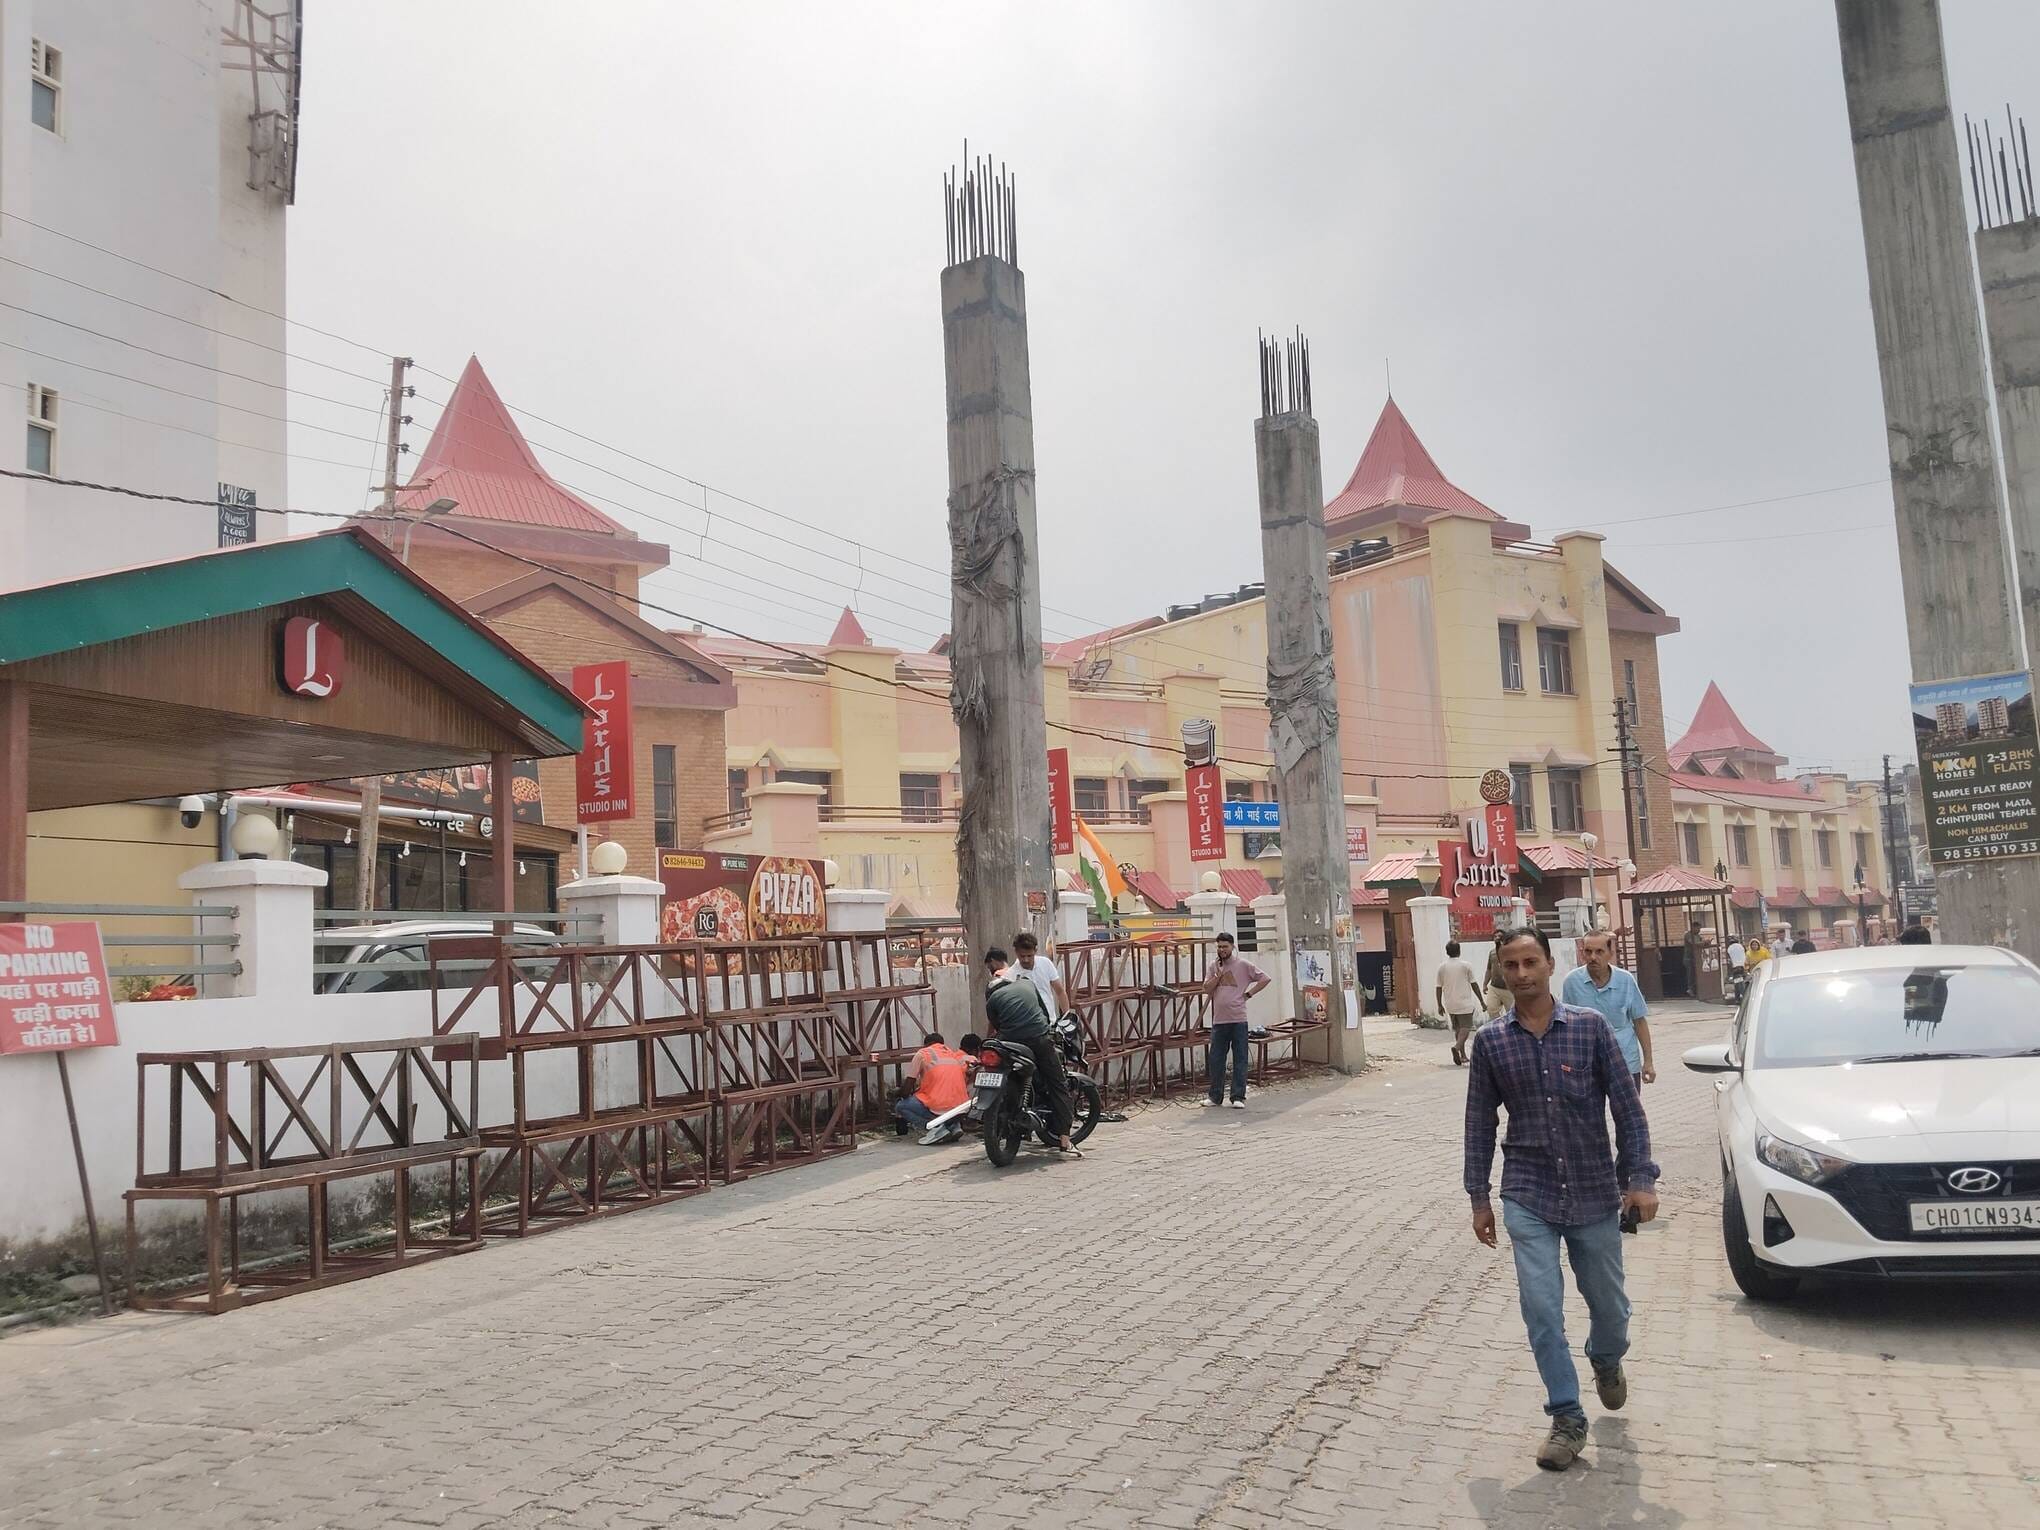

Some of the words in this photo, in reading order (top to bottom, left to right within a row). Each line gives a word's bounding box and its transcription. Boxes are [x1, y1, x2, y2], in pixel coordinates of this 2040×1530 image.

[296, 622, 333, 697] L
[1932, 756, 1977, 773] MKM
[1987, 752, 2007, 763] 2-3
[2009, 749, 2034, 760] BHK
[1936, 769, 1975, 780] HOMES
[1994, 760, 2032, 774] FLATS
[1932, 788, 1970, 799] SAMPLE
[1974, 785, 1997, 794] FLAT
[2000, 780, 2033, 792] READY
[579, 801, 610, 814] STUDIO
[612, 799, 628, 811] INN
[1194, 772, 1213, 845] Lords
[1938, 807, 1945, 815] 2
[1949, 803, 1968, 814] KM
[1972, 802, 2000, 812] FROM
[2005, 798, 2032, 808] MATA
[1936, 812, 1995, 825] CHINTPURNI
[2000, 808, 2037, 819] TEMPLE
[1492, 809, 1507, 846] Lor
[1947, 827, 1968, 837] NON
[1971, 822, 2028, 835] HIMACHALIS
[1967, 834, 1988, 843] CAN
[1990, 832, 2009, 841] BUY
[1191, 848, 1211, 857] STUDIO
[1943, 850, 1960, 859] 98
[1964, 847, 1980, 858] 55
[1984, 846, 1998, 856] 19
[2002, 844, 2016, 854] 19
[2021, 842, 2038, 852] 33
[1454, 846, 1510, 897] Lords
[760, 872, 815, 915] PIZZA
[1479, 895, 1500, 907] STUDIO
[699, 913, 715, 932] RG
[25, 925, 54, 949] NO
[0, 951, 90, 977] PARKING
[34, 982, 59, 998] पर
[54, 1003, 100, 1020] करना
